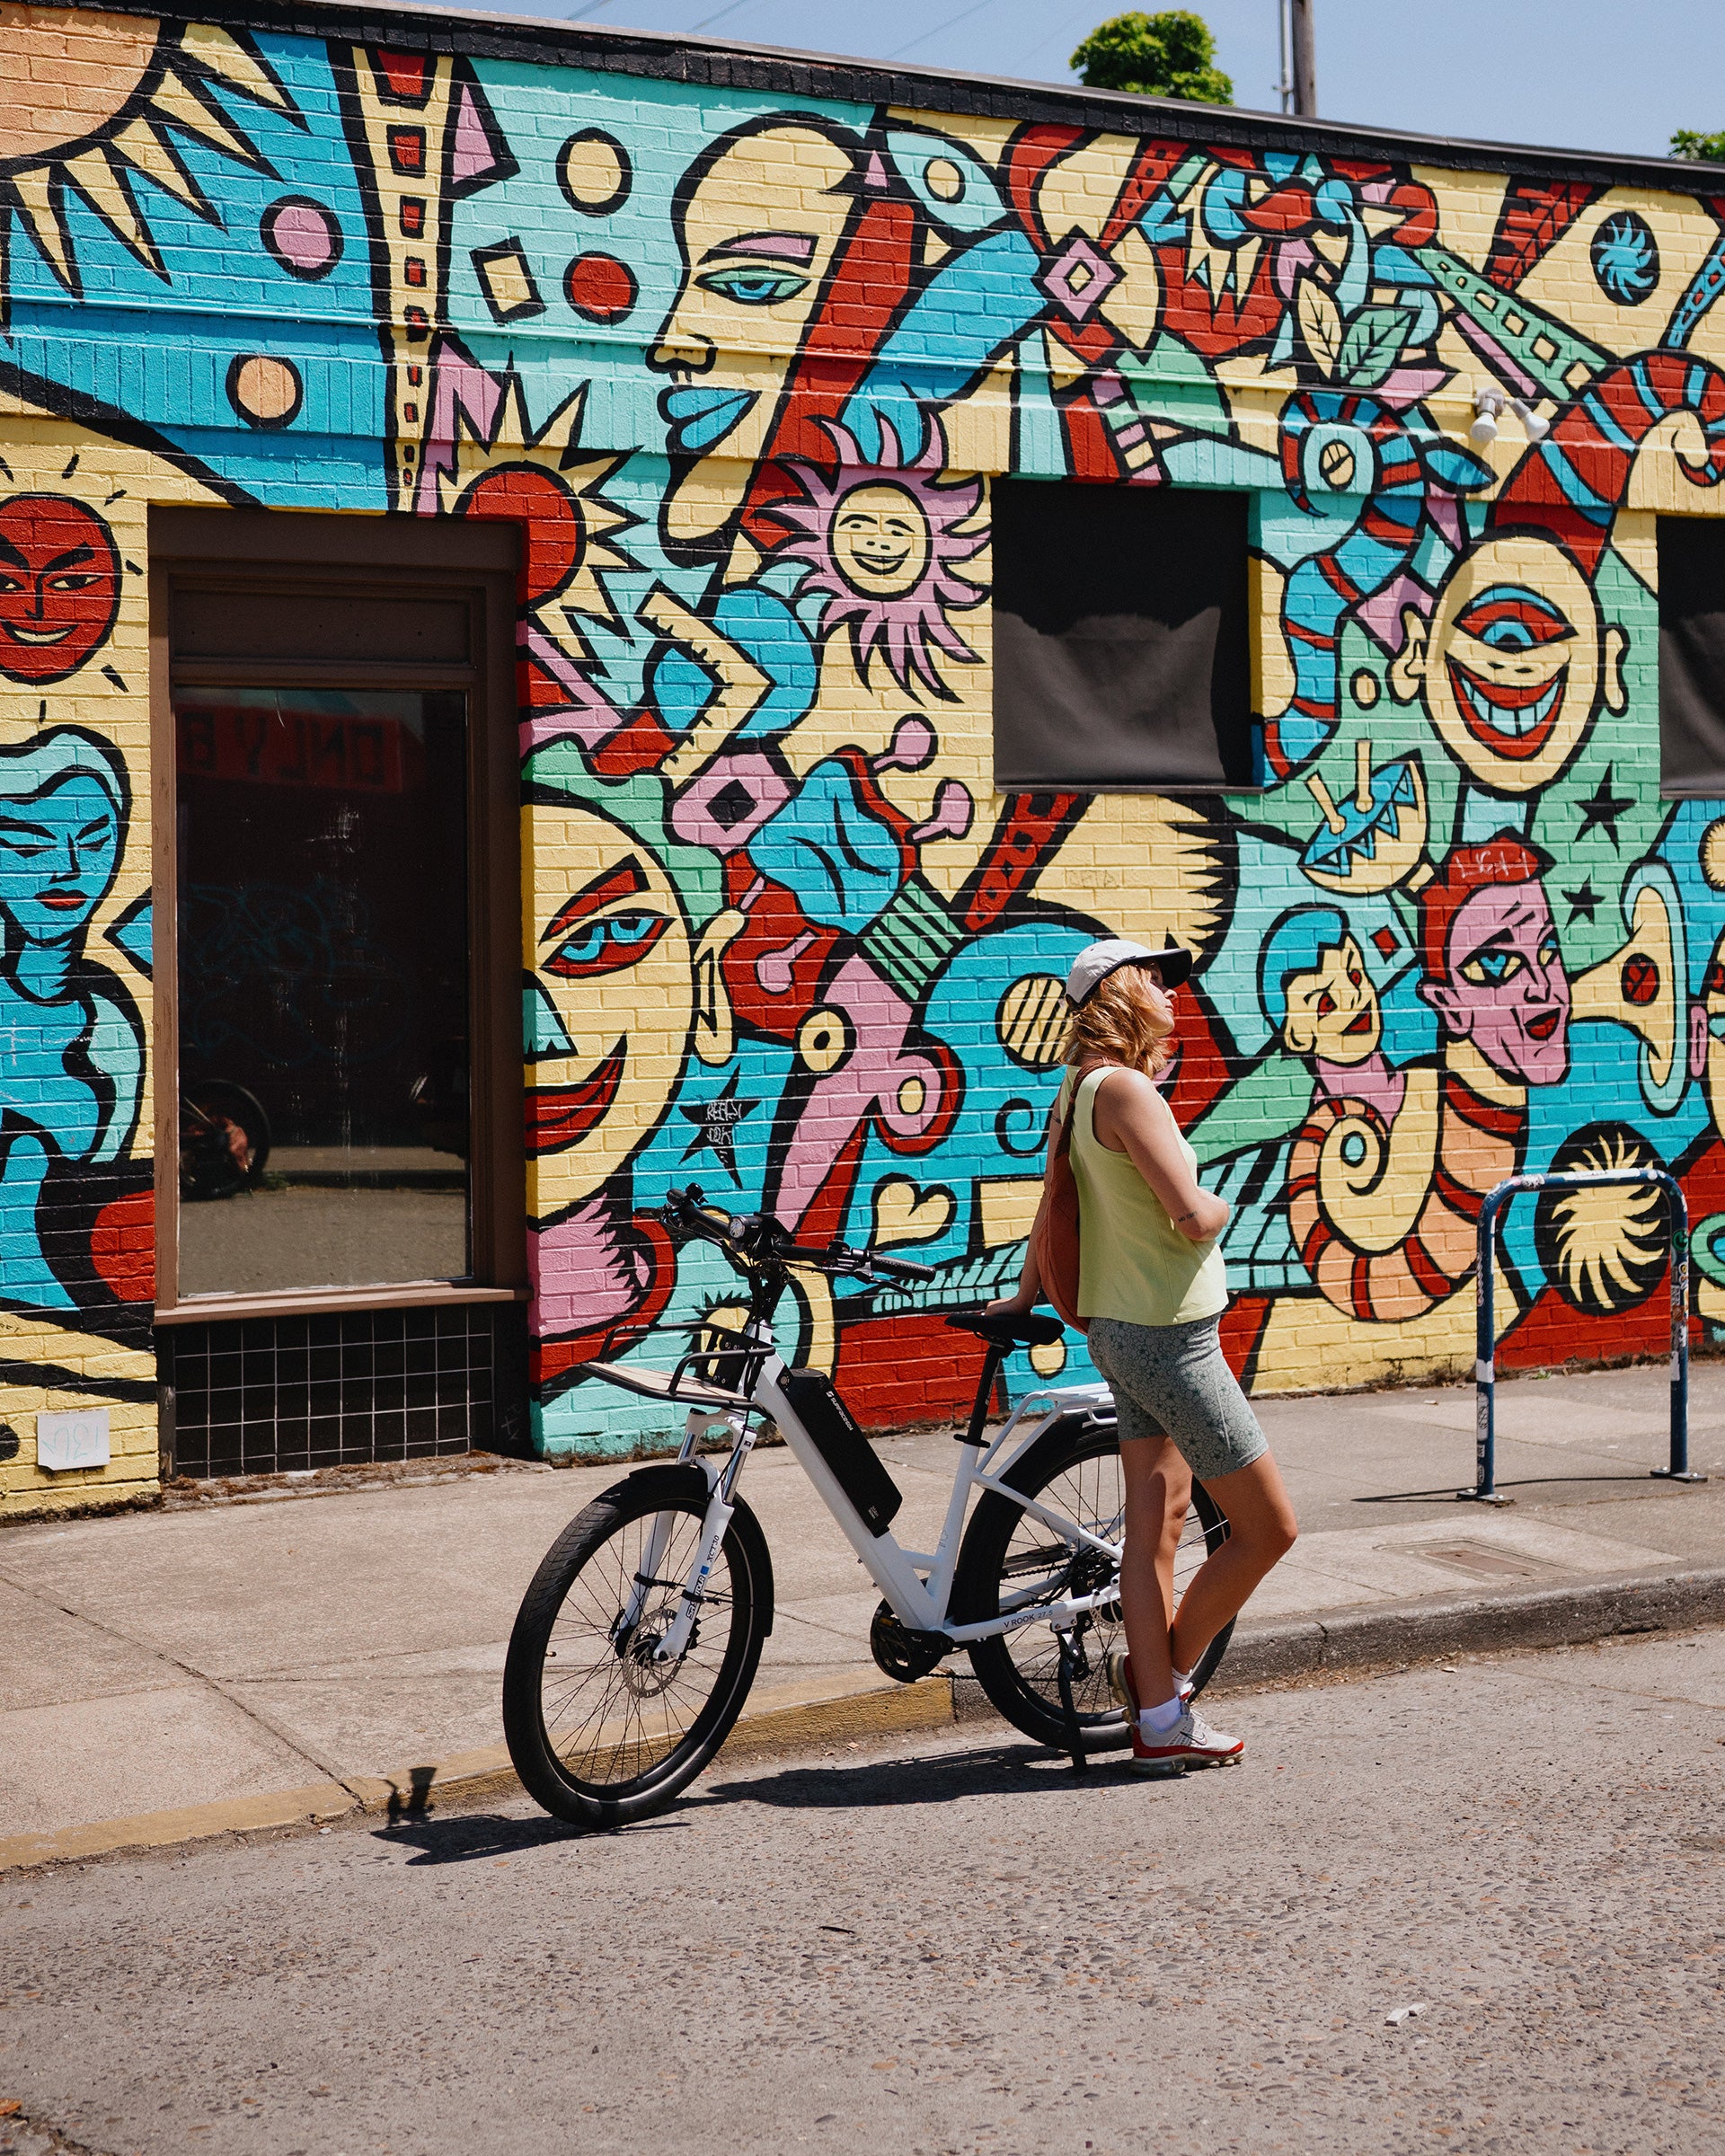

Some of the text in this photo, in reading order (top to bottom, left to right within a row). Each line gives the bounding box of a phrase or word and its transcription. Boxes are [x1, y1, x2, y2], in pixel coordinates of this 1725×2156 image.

[691, 1575, 705, 1606] STOUR
[1011, 1613, 1035, 1626] ROOK
[1037, 1609, 1053, 1619] 27.5
